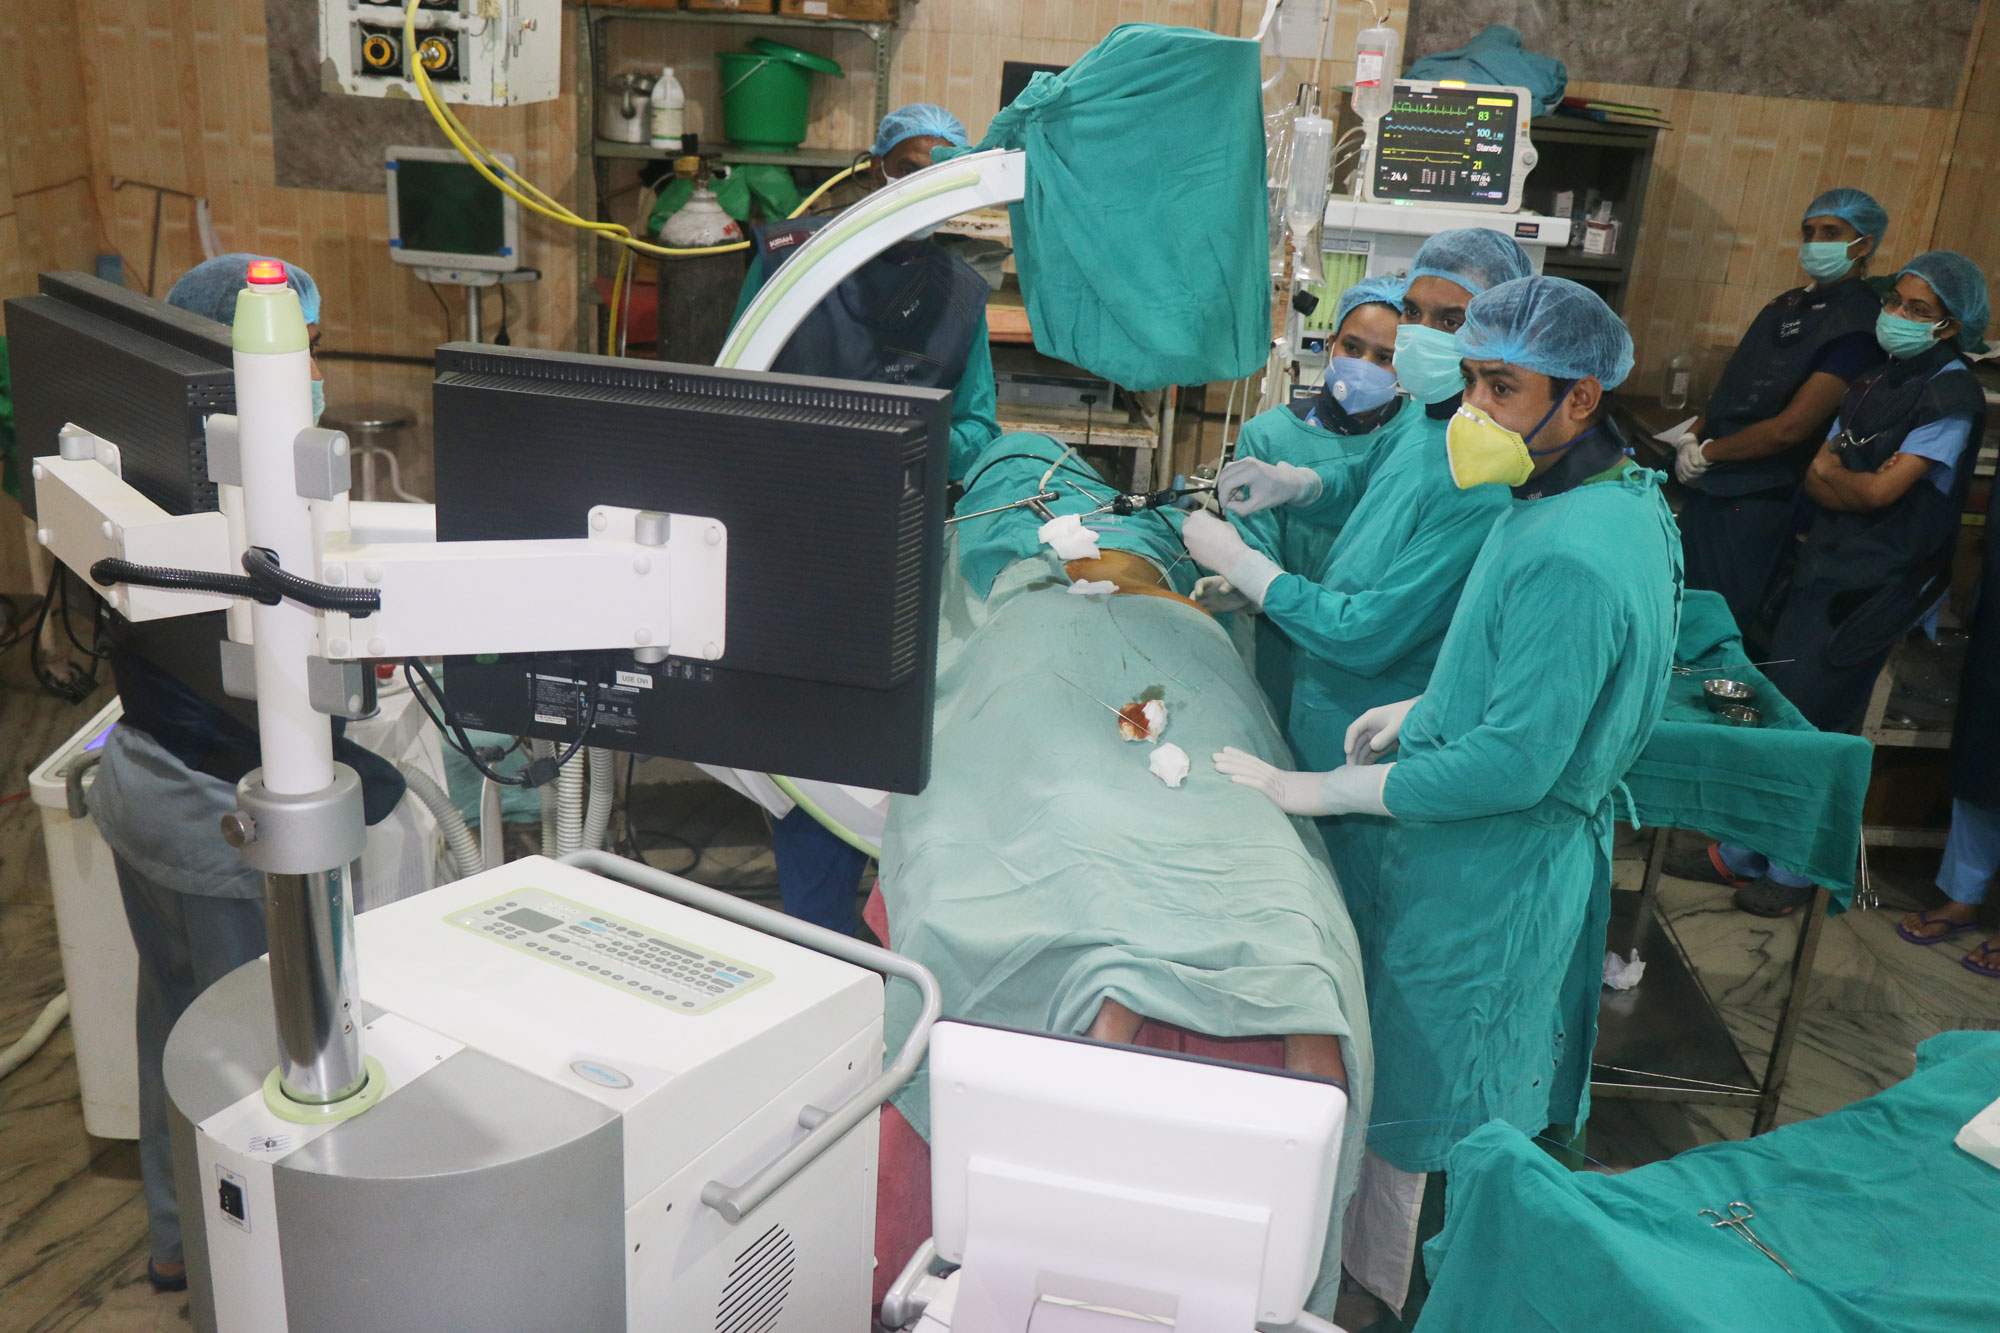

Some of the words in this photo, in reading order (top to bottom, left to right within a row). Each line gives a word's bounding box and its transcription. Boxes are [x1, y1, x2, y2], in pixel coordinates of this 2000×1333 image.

[1478, 111, 1490, 120] 83
[1477, 128, 1491, 137] 100
[1476, 143, 1502, 154] Standby
[1473, 161, 1482, 170] 21
[1391, 171, 1408, 181] 24.4
[621, 675, 635, 683] USE
[636, 676, 649, 685] DVI
